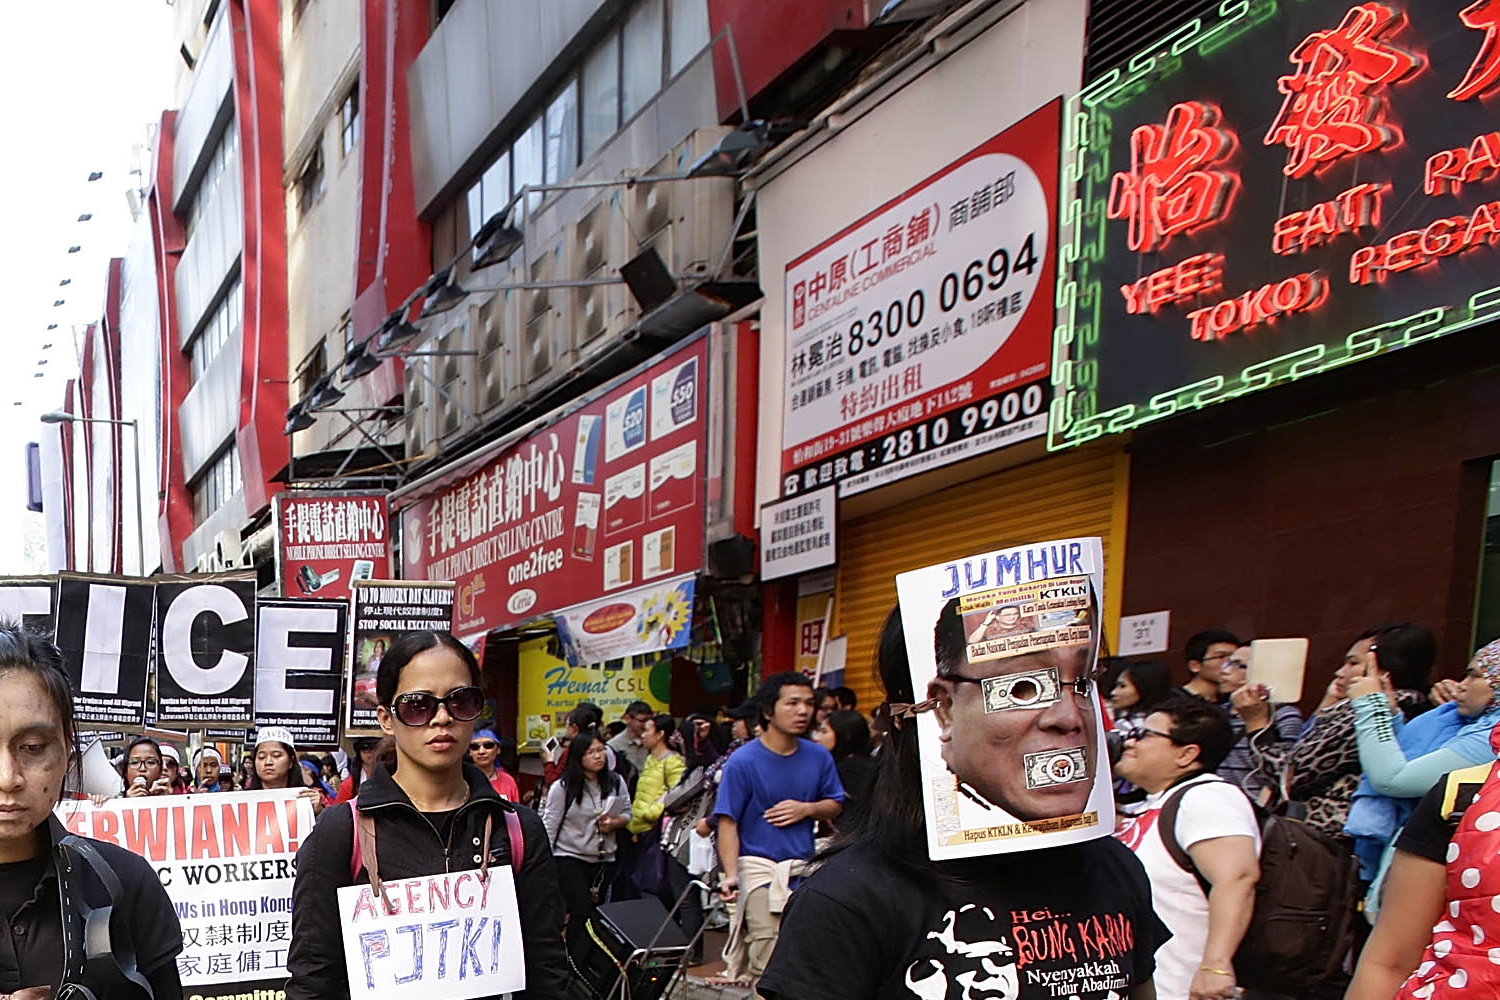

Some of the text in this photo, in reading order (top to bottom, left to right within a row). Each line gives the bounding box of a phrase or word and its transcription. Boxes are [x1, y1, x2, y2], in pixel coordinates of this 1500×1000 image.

[808, 279, 860, 321] CENTALINE
[862, 243, 937, 291] COMMERCIAL
[848, 290, 925, 357] 8300
[939, 232, 1039, 313] 0694
[1120, 253, 1225, 315] YEE
[1187, 270, 1329, 341] TOKO
[881, 416, 950, 465] 2810
[960, 384, 1044, 437] 9900
[428, 432, 565, 558] 手提電話直銷中心
[284, 500, 385, 544] 手提電話直銷中心
[450, 549, 472, 578] PHONE
[472, 534, 499, 569] DIRECT
[498, 520, 530, 560] SELLING
[530, 505, 565, 549] CENTRE
[286, 543, 385, 560] MOBILE PHONE DIRECT SELLING CENTRE
[508, 547, 564, 585] one2free
[941, 543, 1084, 599] JUMHUR
[358, 587, 368, 603] NO
[379, 587, 408, 604] MODERN
[408, 588, 422, 604] DAY
[422, 588, 454, 605] SLAVERY!
[1039, 585, 1087, 600] KTKLN
[358, 620, 378, 630] STOP
[379, 620, 406, 631] SOCIAL
[407, 620, 450, 631] EXCLUSION!
[544, 666, 646, 695] Hemat CSL
[964, 829, 987, 843] Hapus
[987, 825, 1013, 838] KTKLN
[1014, 825, 1022, 835] &
[184, 859, 300, 887] WORKERS
[201, 899, 216, 918] in
[219, 897, 257, 918] Hong
[260, 895, 295, 915] Kong
[351, 870, 492, 923] AGENCY
[358, 915, 504, 990] PJTKI
[1012, 911, 1135, 970] BUNG KARNO
[178, 949, 289, 977] 家庭傭工
[1026, 959, 1121, 987] Nyenyakkah
[1049, 978, 1080, 998] Tidur
